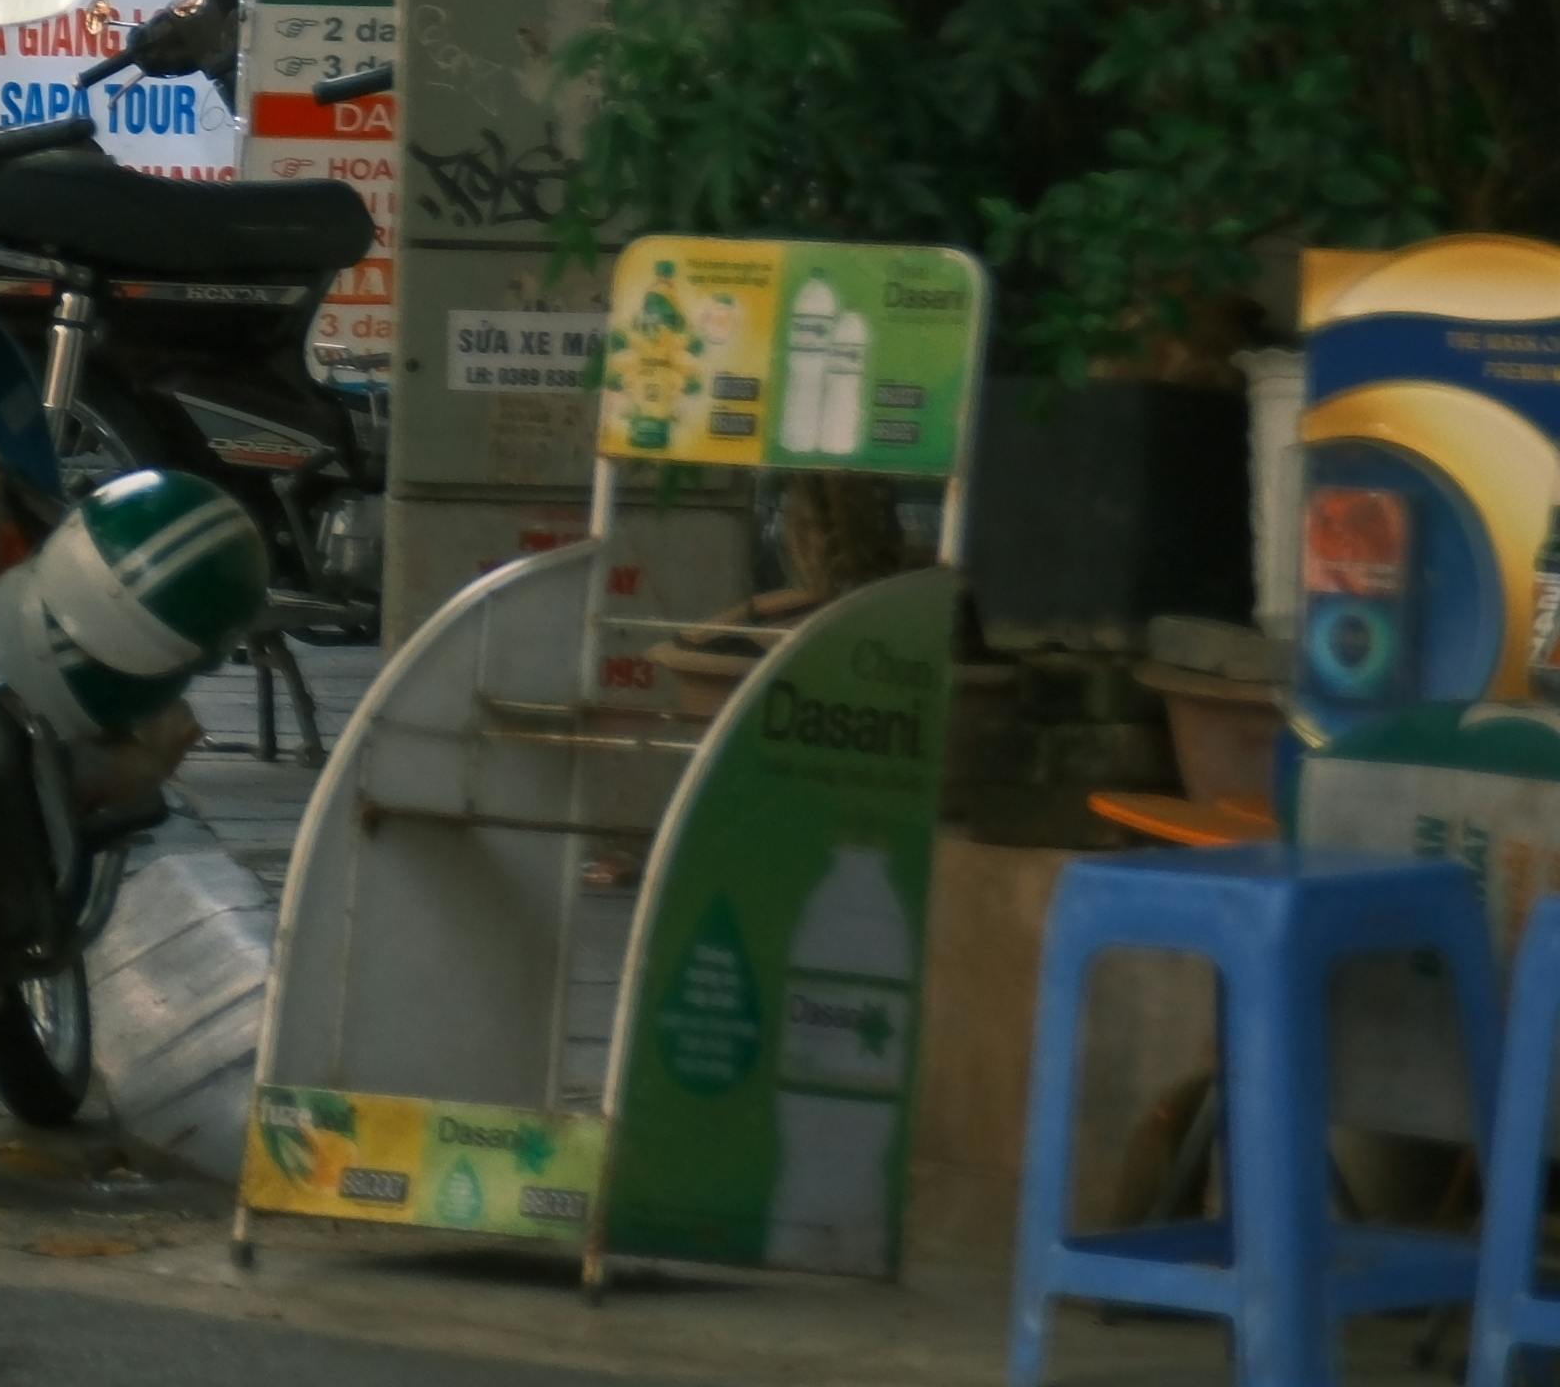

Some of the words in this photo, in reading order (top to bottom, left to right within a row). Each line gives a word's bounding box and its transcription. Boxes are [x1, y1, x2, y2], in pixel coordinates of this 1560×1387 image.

[323, 17, 344, 42] 2
[323, 54, 342, 78] 3
[0, 80, 91, 128] SAPA
[104, 82, 197, 136] TOUR
[328, 157, 394, 181] HOA
[186, 285, 269, 302] HONDA
[319, 314, 338, 338] 3
[458, 317, 511, 356] SỬA
[520, 331, 552, 356] XE
[759, 680, 925, 759] Dasani
